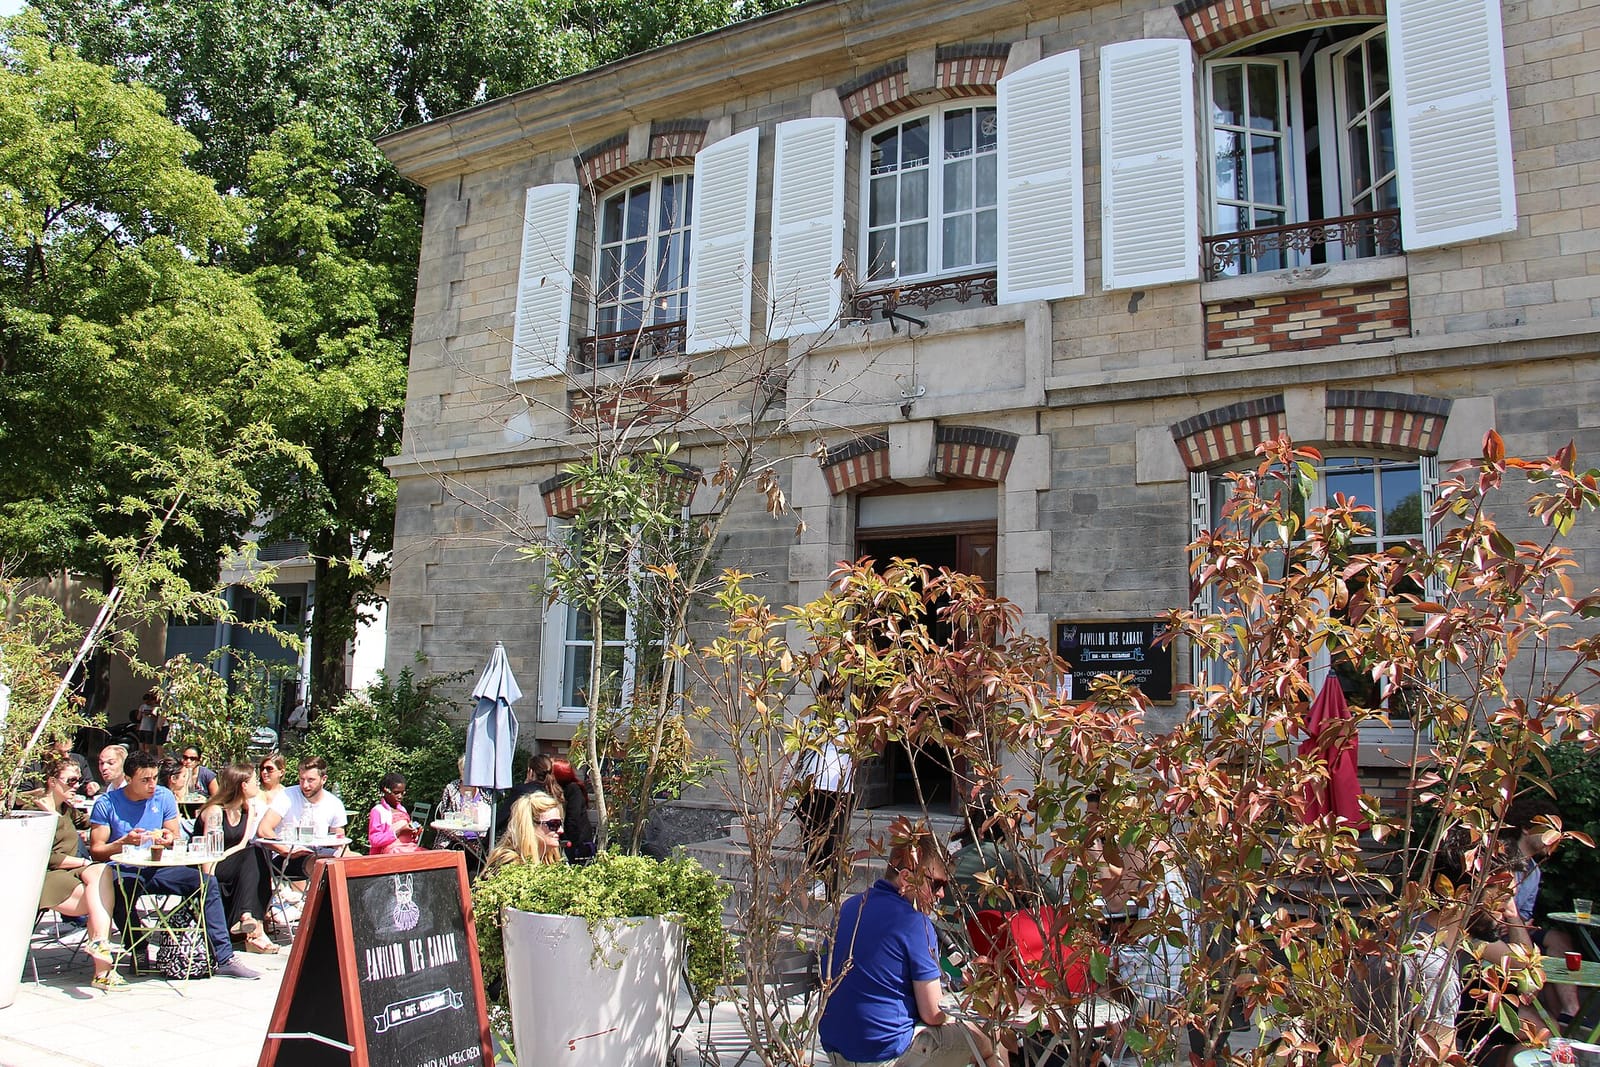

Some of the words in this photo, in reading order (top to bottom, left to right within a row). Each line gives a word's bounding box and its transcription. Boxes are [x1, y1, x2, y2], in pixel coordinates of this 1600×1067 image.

[1080, 632, 1104, 645] PAVILLON
[1109, 632, 1118, 645] DES
[1122, 632, 1143, 645] CANAUX
[366, 943, 405, 981] PAVILLON
[410, 939, 425, 972] DES
[428, 933, 458, 968] CANAUX
